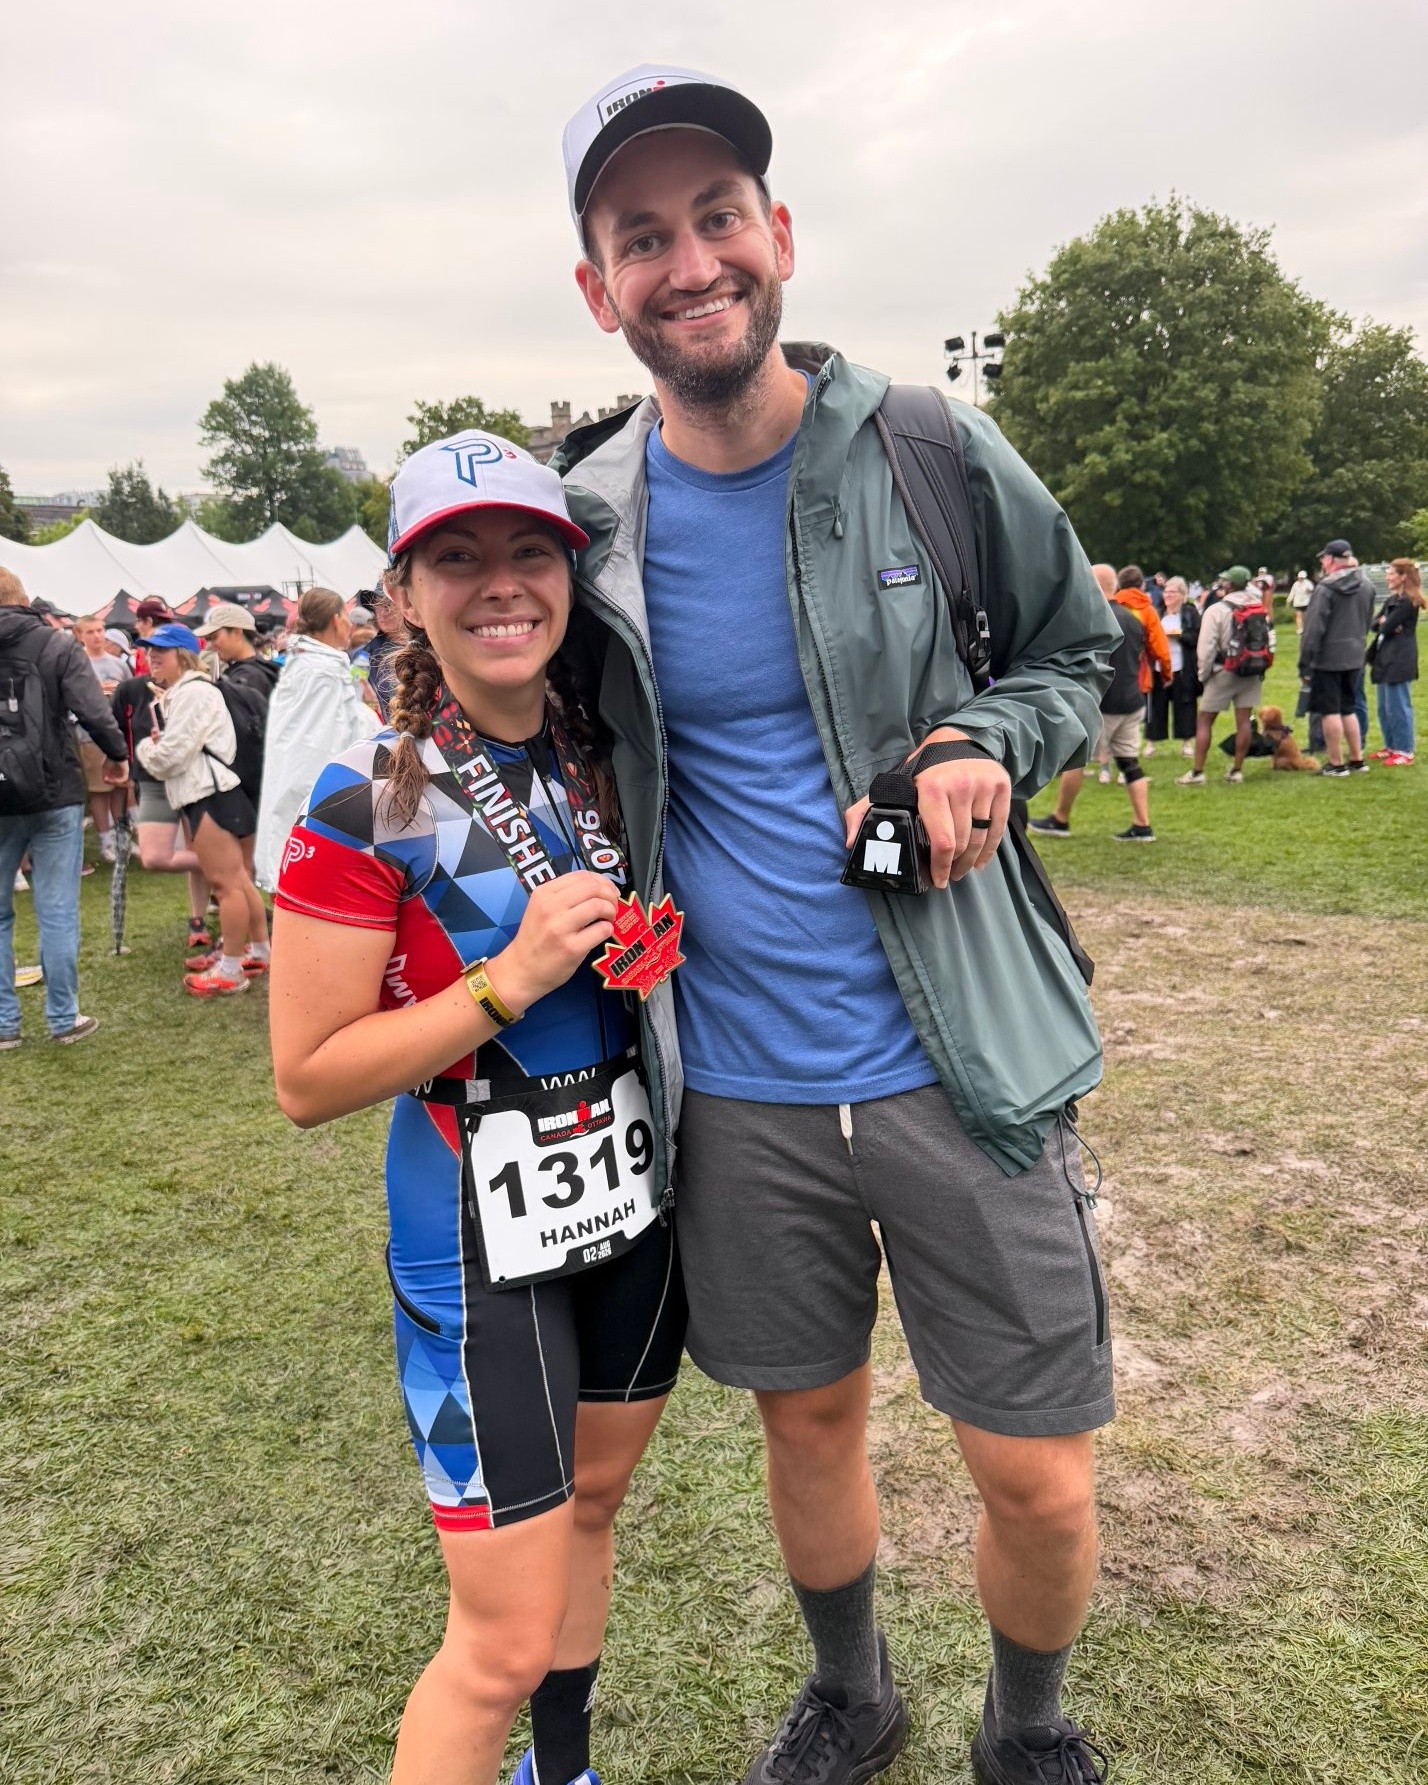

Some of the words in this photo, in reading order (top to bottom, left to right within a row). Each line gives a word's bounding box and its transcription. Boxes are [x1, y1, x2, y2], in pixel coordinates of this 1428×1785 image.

[606, 80, 665, 117] IRON
[456, 753, 557, 890] FINISHE
[479, 996, 511, 1029] IRON
[537, 1098, 612, 1133] IRONMAN
[540, 1129, 572, 1142] CANADA
[587, 1115, 612, 1129] OTTAWA
[488, 1118, 655, 1220] 1319
[539, 1197, 637, 1249] HANNAH
